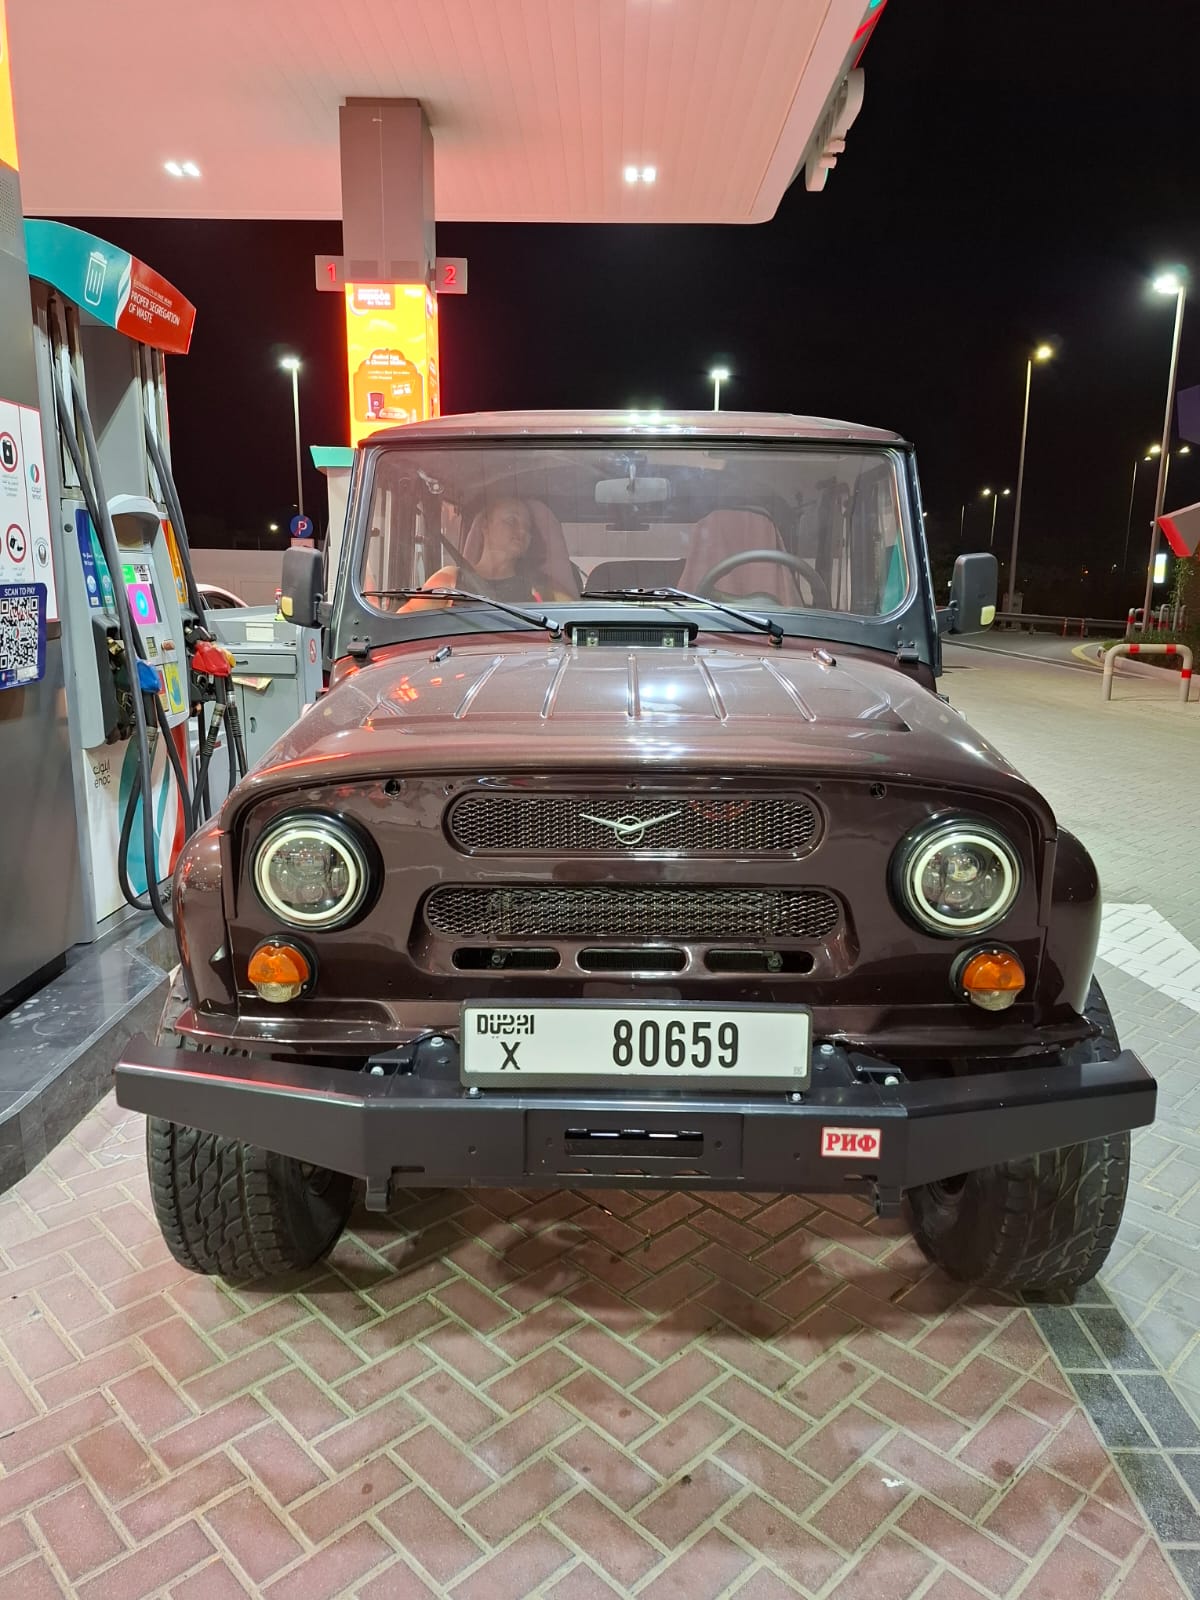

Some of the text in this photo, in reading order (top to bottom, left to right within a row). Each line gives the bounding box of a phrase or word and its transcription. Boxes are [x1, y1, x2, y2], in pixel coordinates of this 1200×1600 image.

[327, 263, 337, 282] 1
[444, 265, 457, 284] 2
[128, 303, 153, 324] OF WASTE
[130, 291, 150, 309] PROPER
[149, 300, 180, 326] SEGREGATION
[4, 586, 36, 597] SCAN TO PAY
[95, 774, 111, 788] enoc
[612, 1019, 739, 1069] 80659
[500, 1041, 521, 1070] X
[825, 1132, 877, 1152] РИФ
